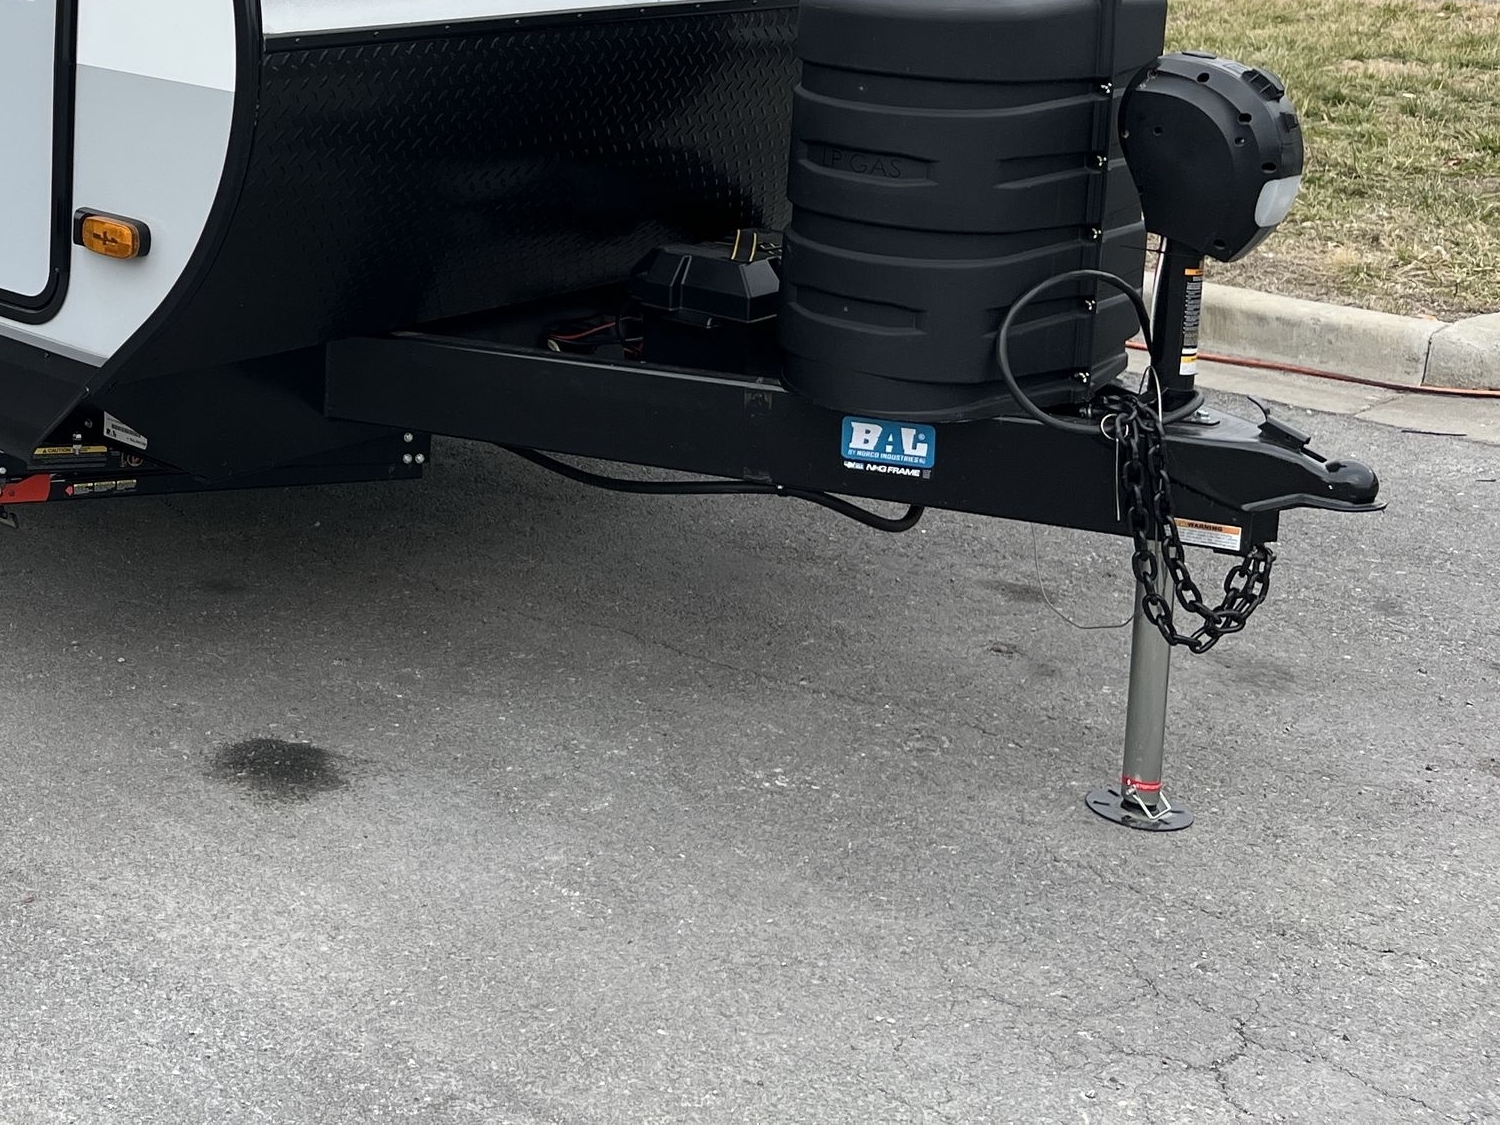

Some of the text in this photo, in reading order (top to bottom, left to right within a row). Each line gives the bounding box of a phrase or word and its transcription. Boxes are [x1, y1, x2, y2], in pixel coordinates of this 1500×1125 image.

[849, 153, 902, 179] GAS
[857, 450, 880, 458] NORCO
[880, 453, 918, 463] INDUSTRIES
[887, 466, 921, 477] FRAME
[1188, 522, 1223, 532] WARNING
